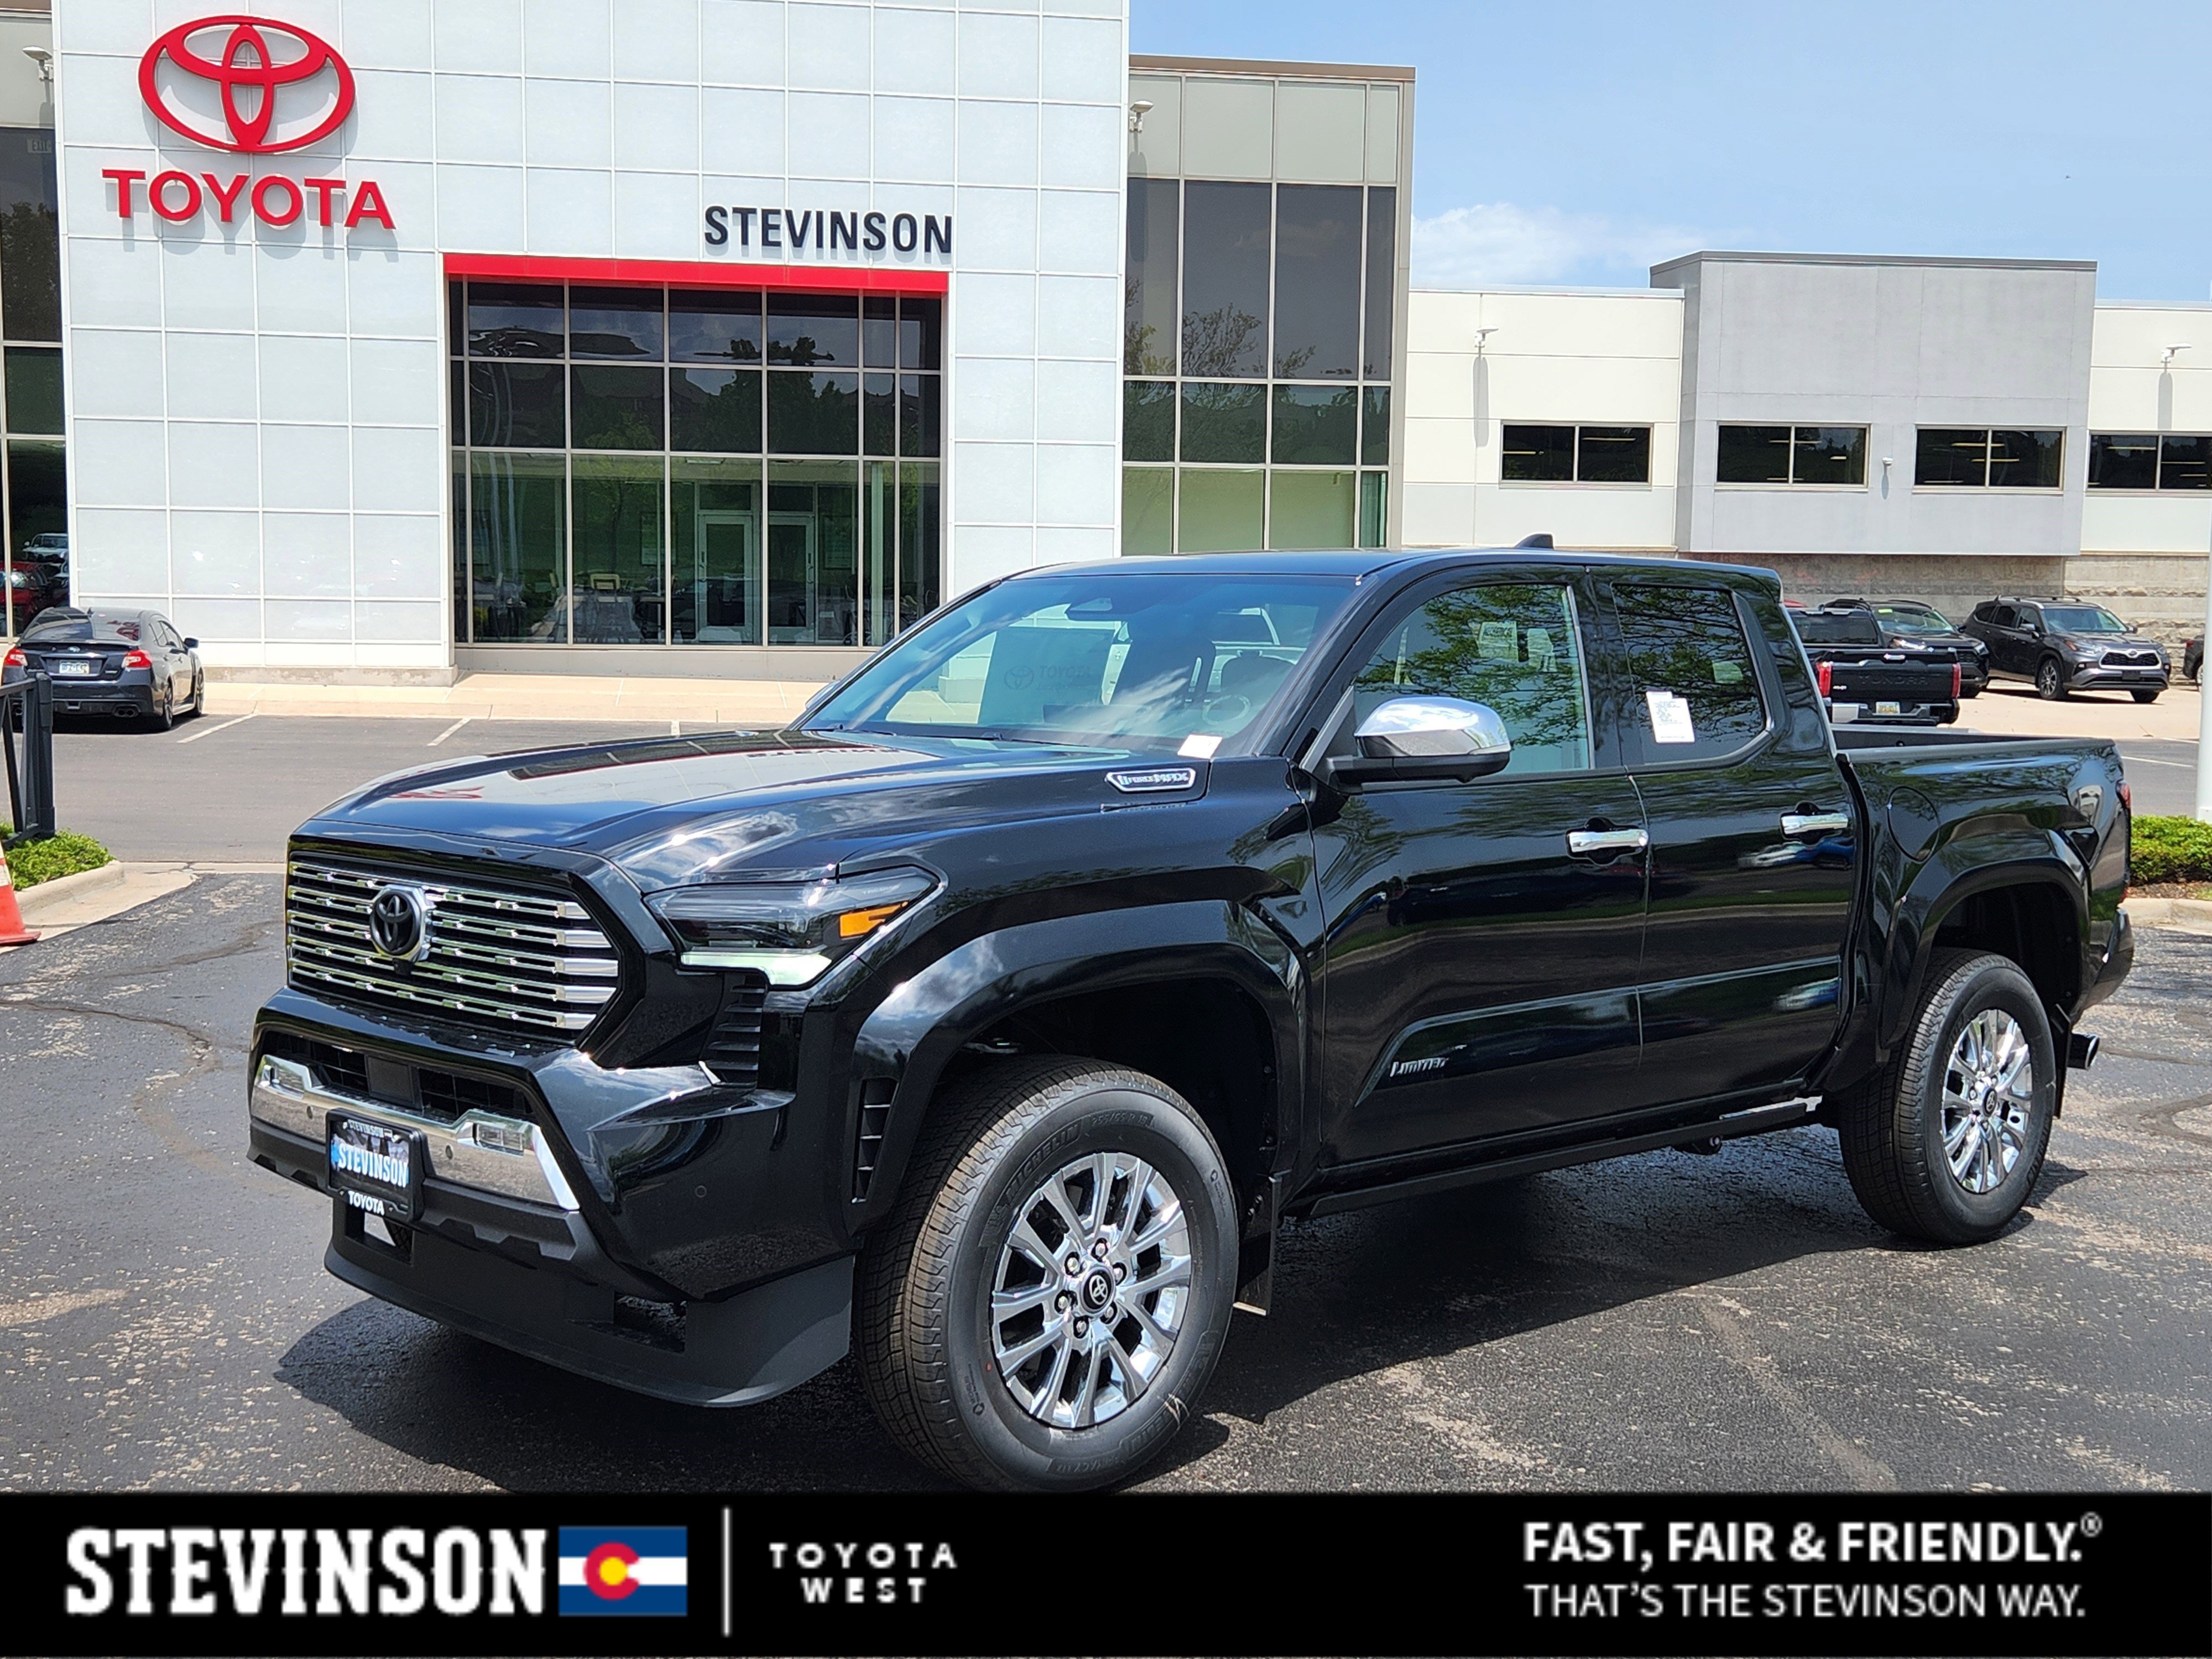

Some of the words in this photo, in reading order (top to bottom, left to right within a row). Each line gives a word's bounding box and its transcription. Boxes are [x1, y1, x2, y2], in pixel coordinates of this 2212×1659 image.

[102, 169, 396, 229] TOYOTA
[704, 206, 952, 254] STEVINSON
[1859, 674, 1928, 685] TUNDRA
[338, 1142, 409, 1188] STEVINSON
[1006, 1124, 1080, 1203] MICHELIN
[348, 1190, 385, 1216] TOYOTA
